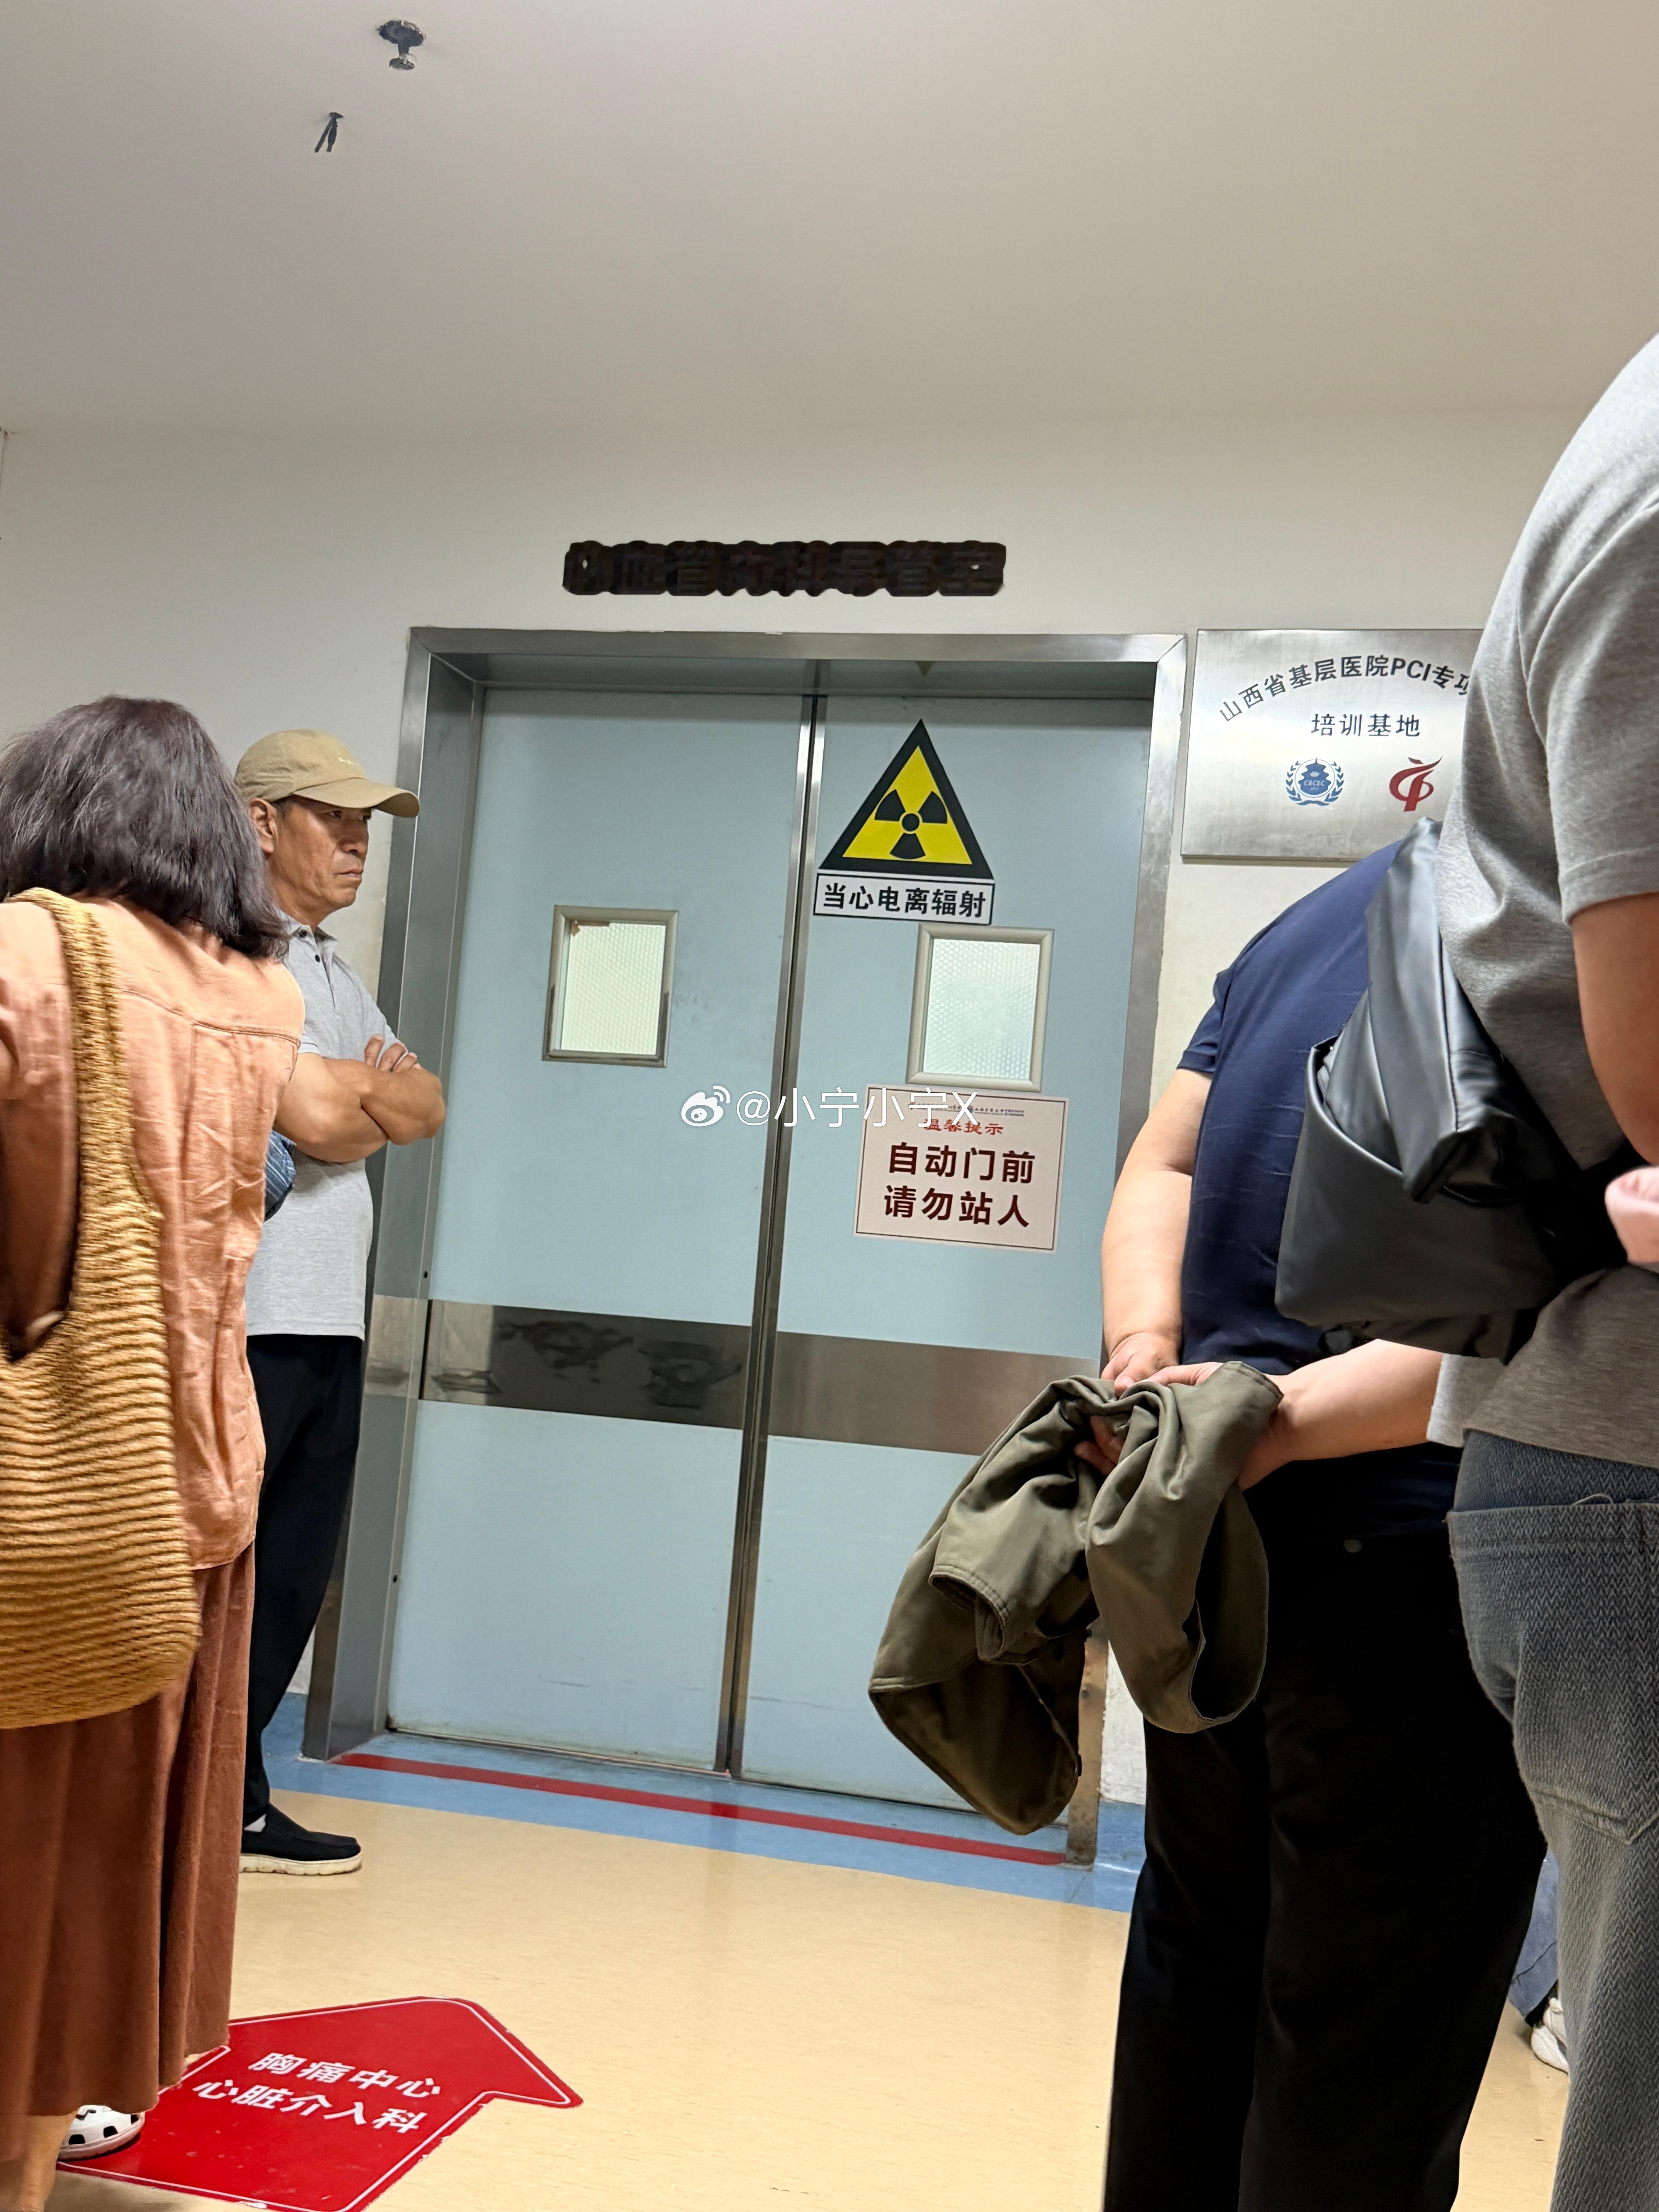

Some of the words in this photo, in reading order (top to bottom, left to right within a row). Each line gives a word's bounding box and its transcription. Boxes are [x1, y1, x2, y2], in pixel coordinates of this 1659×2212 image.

[1312, 714, 1420, 737] 培训基地
[823, 883, 986, 918] 当心电离辐射
[924, 1118, 1004, 1135] 温馨提示
[889, 1142, 1035, 1183] 自动门前
[884, 1185, 1029, 1228] 请勿站人
[248, 2052, 441, 2098] 胸痛中心
[192, 2080, 428, 2133] 心脏介入科
